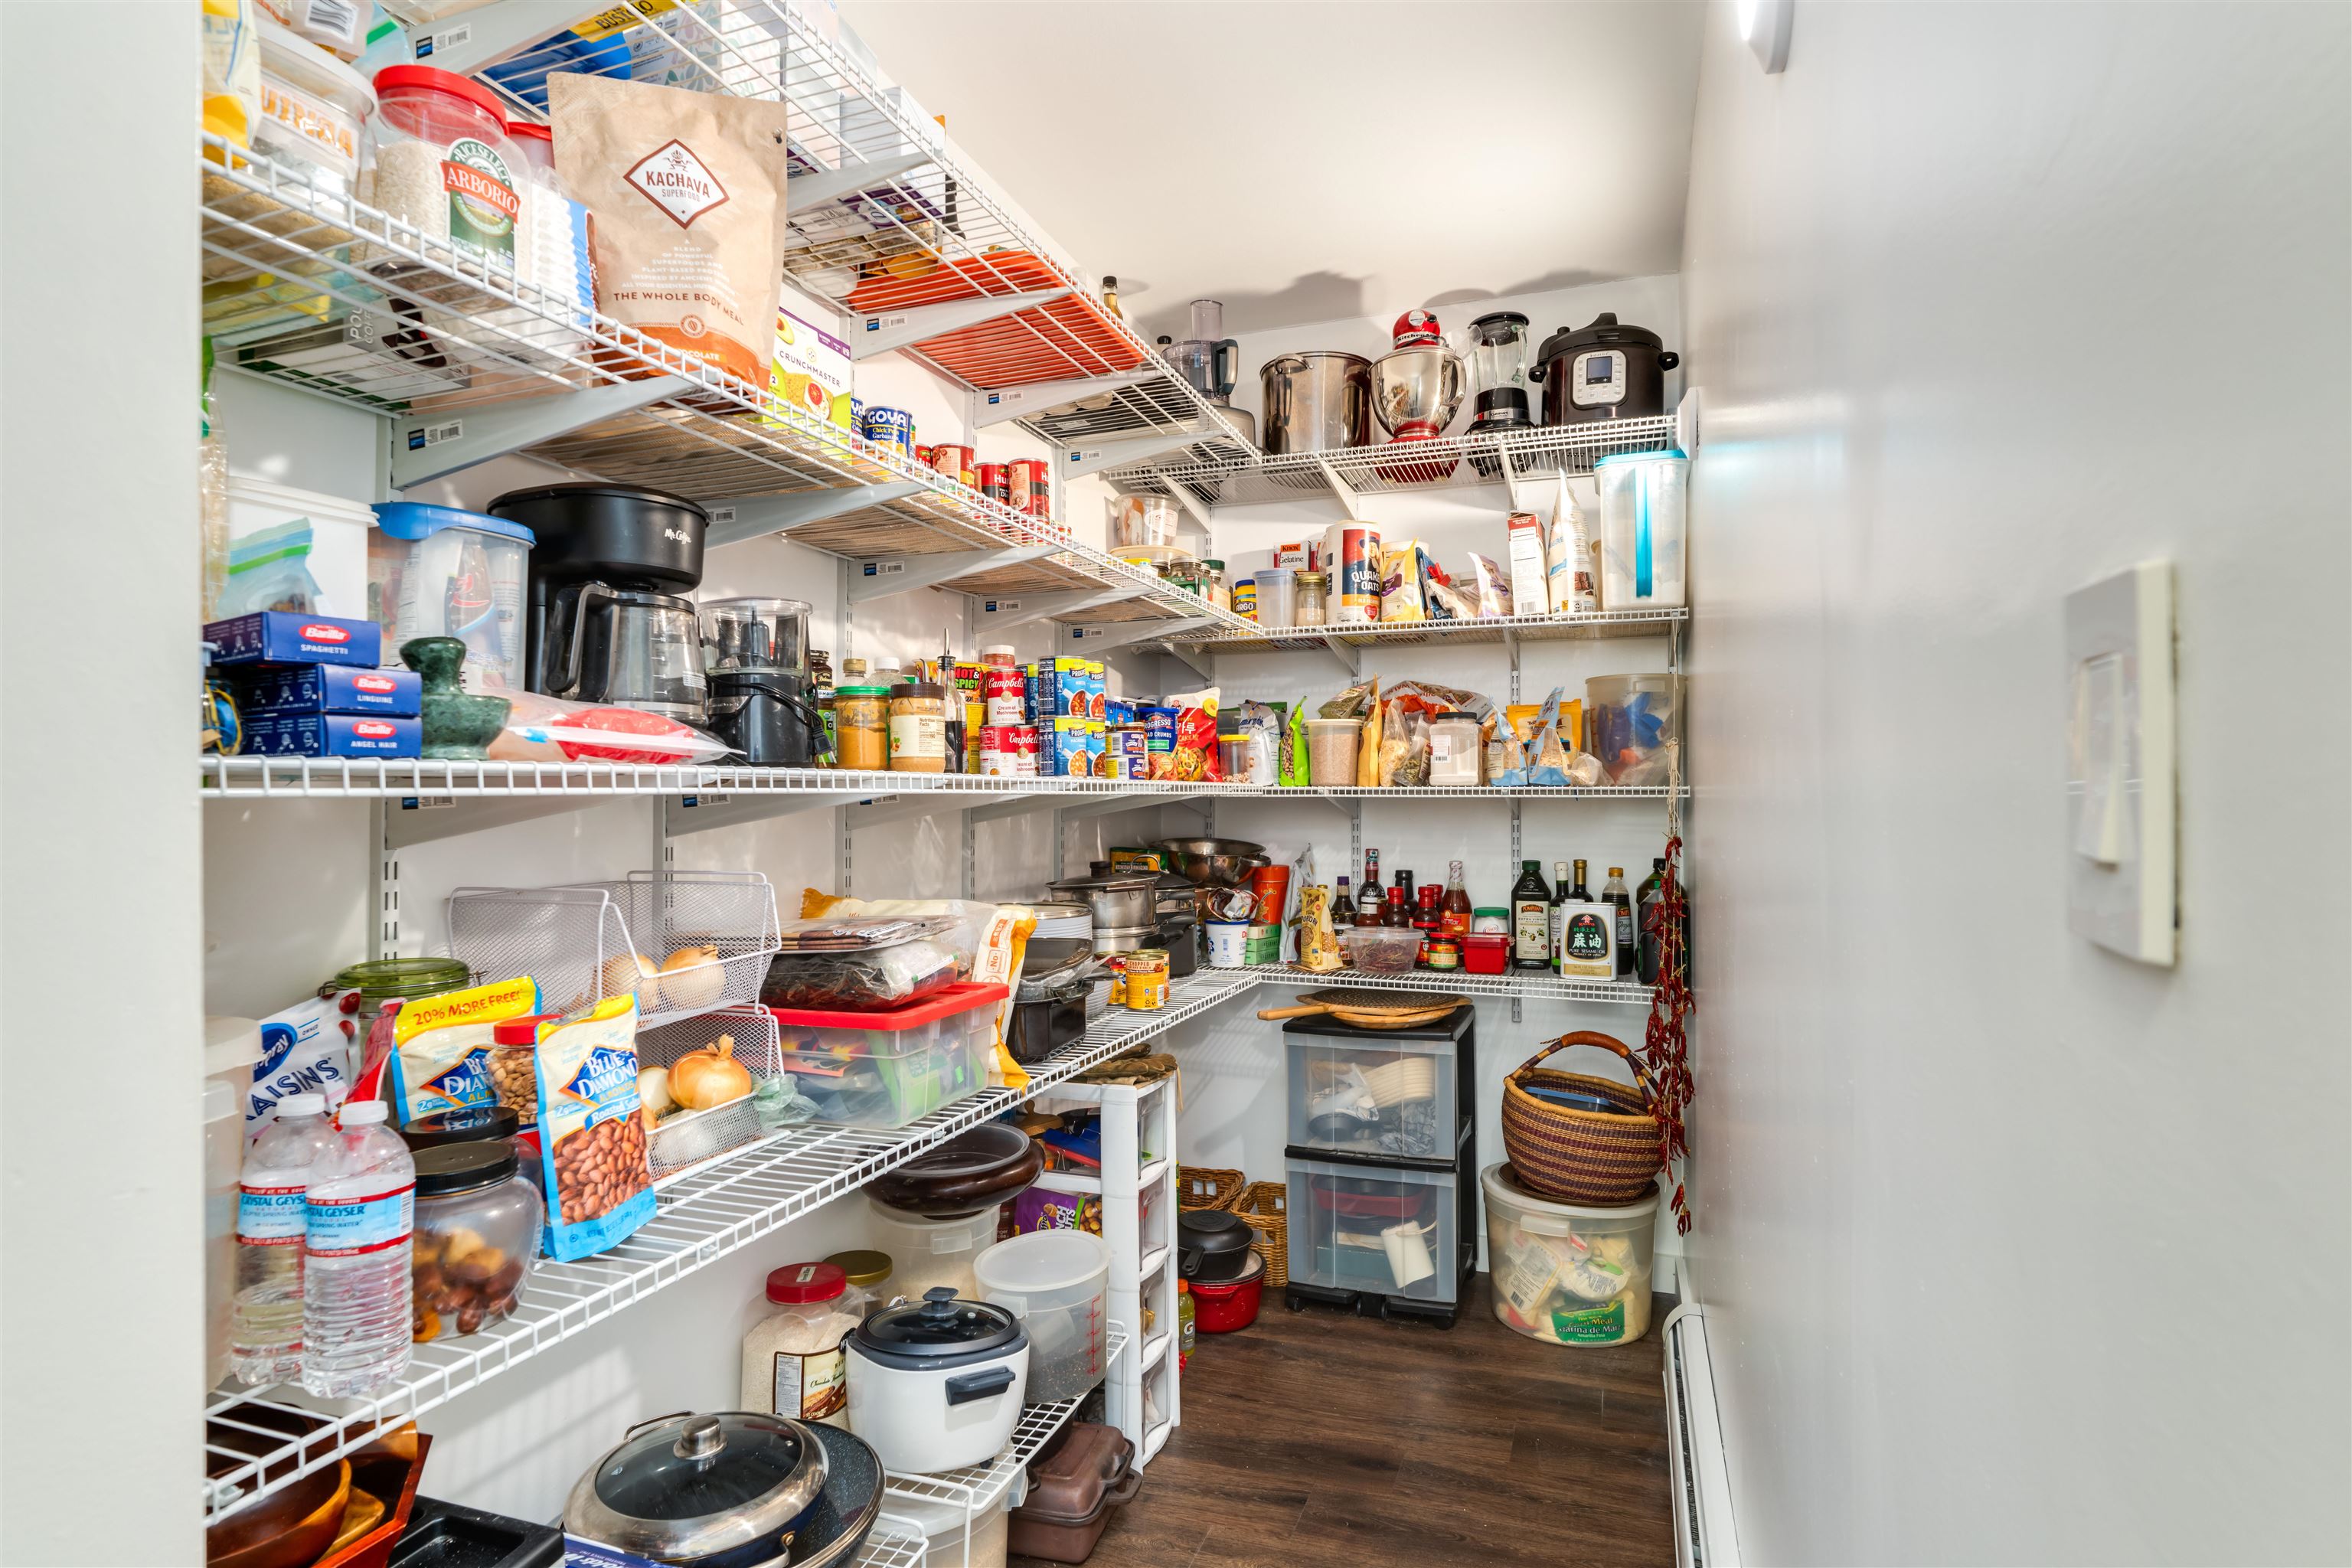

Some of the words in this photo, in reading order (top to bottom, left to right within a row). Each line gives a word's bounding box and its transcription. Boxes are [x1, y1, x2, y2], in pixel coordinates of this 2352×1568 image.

[261, 85, 353, 158] UINOA
[446, 167, 518, 214] ARBORIO
[662, 188, 701, 201] SUPERFOOD
[614, 292, 638, 301] THE
[642, 292, 689, 301] WHOLE
[694, 293, 721, 310] BODY
[723, 307, 744, 325] MEAL
[779, 350, 841, 387] CRUNCHMASTER
[851, 400, 863, 416] YA
[868, 410, 906, 430] GOYA
[1351, 570, 1380, 583] QUAKE
[1361, 582, 1380, 591] OATS
[1235, 603, 1254, 612] ARGO
[305, 626, 347, 642] Barilla
[300, 644, 348, 655] SPAGHETTI
[358, 678, 393, 691] Barilla
[357, 694, 393, 704] LINGUINE
[358, 724, 393, 736] Barilla
[1145, 719, 1171, 730] ROGRESSO
[351, 740, 377, 749] ANGEL
[379, 740, 397, 749] HAIR
[413, 1008, 446, 1026] 20%
[448, 998, 485, 1018] MORE
[488, 990, 521, 1007] FREE!
[302, 1024, 318, 1036] OWNED
[586, 1052, 626, 1078] BLUE
[577, 1057, 638, 1099] DIAMOND
[247, 1060, 339, 1119] AISINS
[599, 1080, 635, 1102] ALMONDS
[591, 1102, 625, 1124] Roasted
[242, 1196, 273, 1206] CRYSTAL
[276, 1196, 306, 1205] GEYS
[306, 1207, 322, 1217] STAL
[325, 1206, 364, 1217] GEYSER
[810, 1377, 831, 1389] Chocolate
